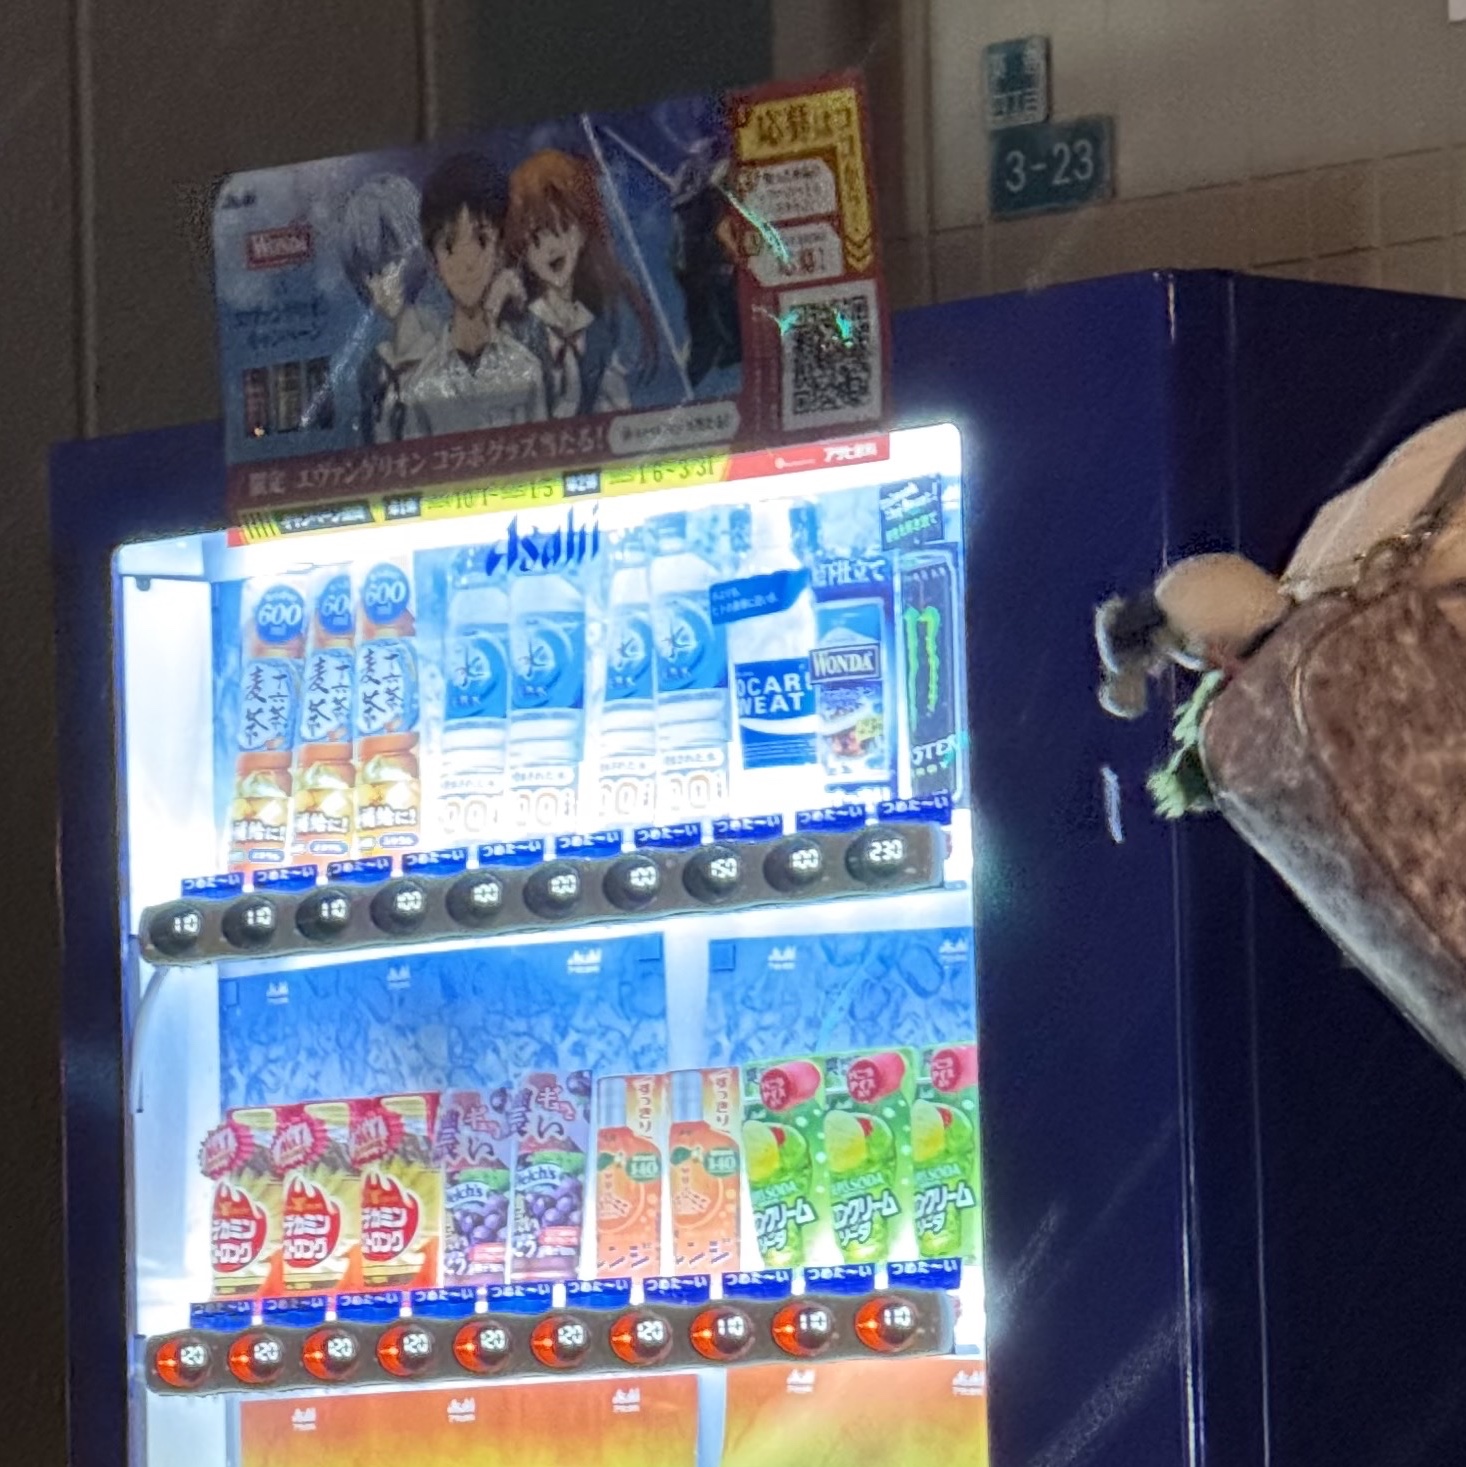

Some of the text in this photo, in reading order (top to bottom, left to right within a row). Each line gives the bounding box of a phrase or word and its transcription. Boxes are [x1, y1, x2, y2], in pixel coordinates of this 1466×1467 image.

[1006, 139, 1093, 191] 3-23
[297, 454, 426, 488] エヴァンゲリオン
[365, 581, 407, 607] 600
[259, 603, 302, 627] 600
[815, 650, 873, 678] WONDA
[868, 839, 904, 862] 230
